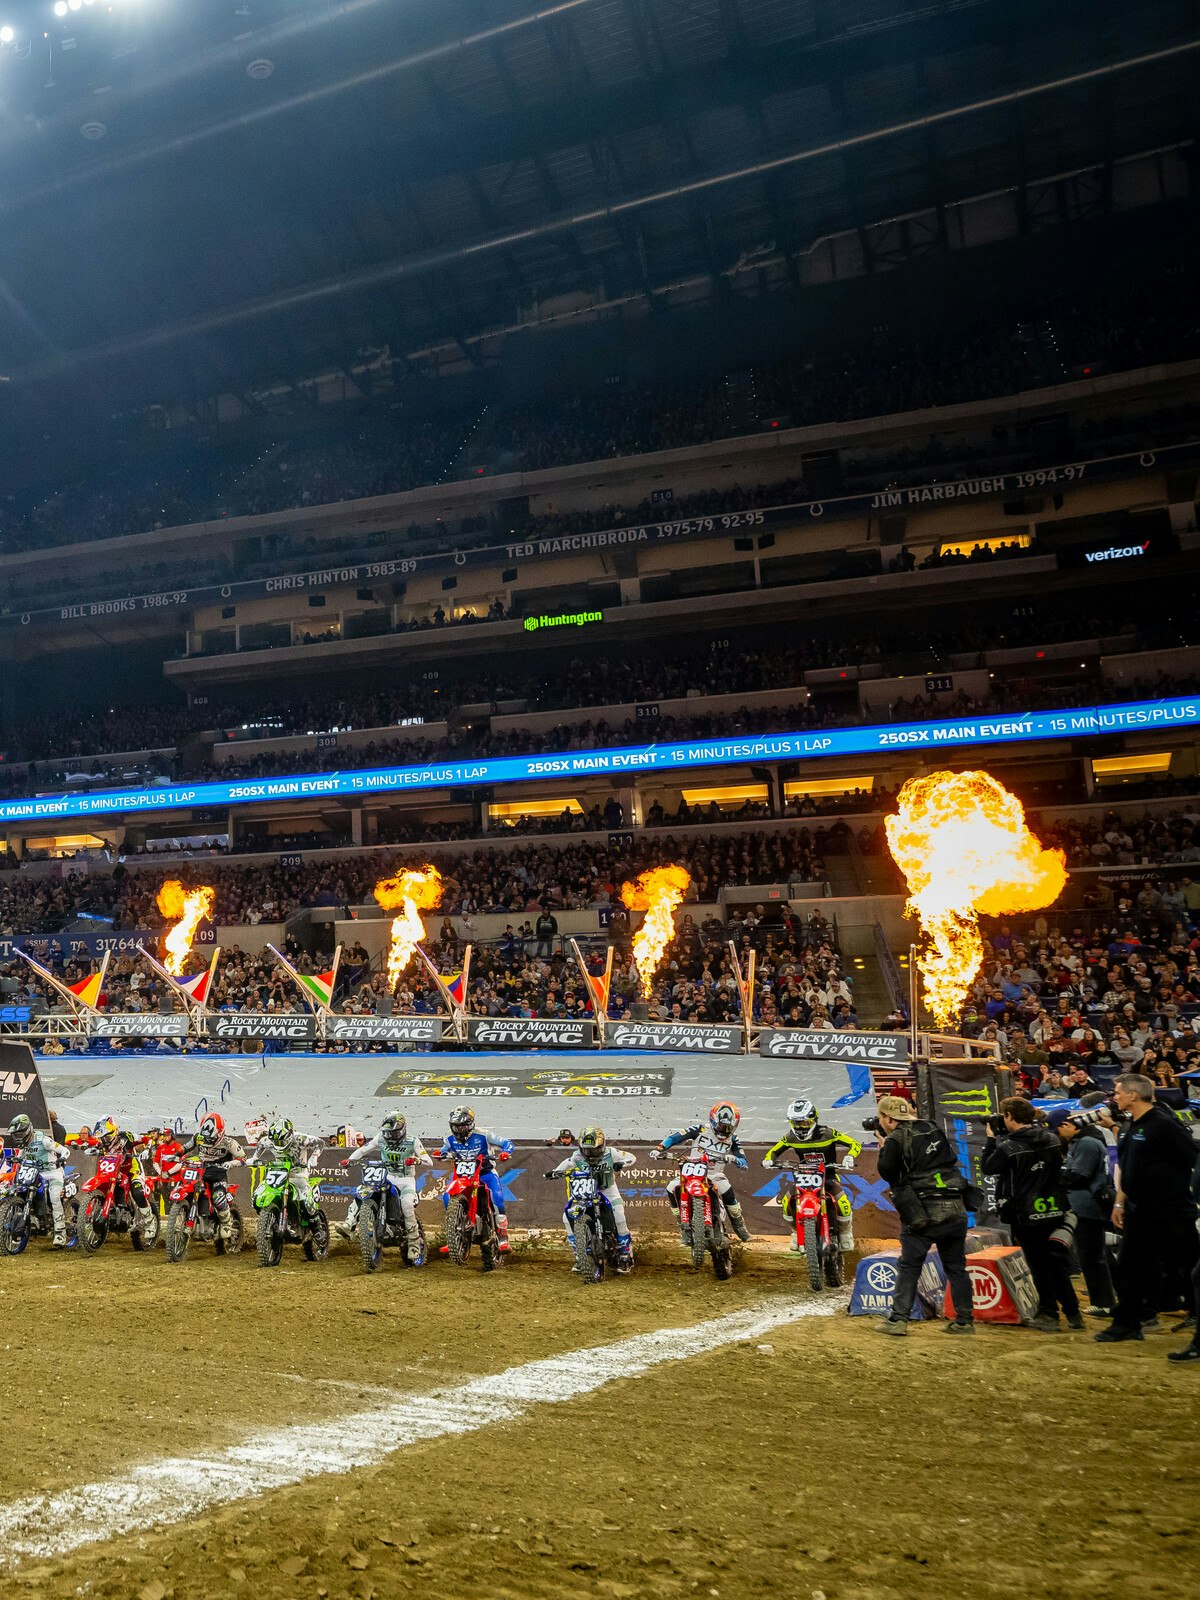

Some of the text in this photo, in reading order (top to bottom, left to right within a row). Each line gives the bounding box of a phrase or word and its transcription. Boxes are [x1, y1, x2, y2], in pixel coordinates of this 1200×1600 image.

[870, 465, 1087, 510] JIM HARBAUGH 1994-97
[653, 491, 671, 501] 510
[506, 511, 765, 559] TED MARCHIBRODA 92-95
[1084, 544, 1145, 562] verizon
[265, 560, 417, 592] CHRIS HINTON 1983-89
[61, 593, 187, 620] BILL BROOKS 1986-92
[539, 611, 603, 628] Huntington
[710, 639, 730, 651] 410
[422, 671, 439, 680] 409
[928, 678, 952, 690] 311
[637, 706, 658, 717] 310
[879, 706, 1197, 745] 250SX MAIN EVENT 15 MINUTES/PLUS
[319, 738, 337, 747] 309
[527, 738, 832, 774] 250SX MAIN EVENT 15 MINUTES/PLUS LAP
[229, 768, 487, 797] 250SX MAIN EVENT 15 MINUTES/PLUS LAP
[7, 805, 33, 816] MAIN
[35, 802, 69, 814] EVENT
[79, 801, 90, 810] 15
[91, 794, 166, 811] MINUTES/PLUS
[176, 792, 195, 803] LAP
[282, 856, 301, 867] 209
[110, 1016, 183, 1024] ROCKY MOUNTAIN
[230, 1017, 308, 1025] ROCKY MOUNTAIN
[350, 1018, 434, 1028] ROCKY MOUNTAIN
[492, 1021, 583, 1032] ROCKY MOUNTAIN
[633, 1024, 731, 1038] ROCKY MOUNTAIN
[789, 1032, 898, 1046] ROCKY MOUNTAIN
[401, 1085, 511, 1097] HARDER
[544, 1085, 663, 1097] HARDER
[965, 1121, 973, 1136] AMA
[384, 1145, 407, 1153] THOR
[699, 1136, 730, 1152] FXR
[100, 1161, 116, 1172] 96
[456, 1162, 477, 1175] 63
[681, 1162, 706, 1176] 66
[184, 1170, 198, 1180] 91
[266, 1171, 288, 1185] 57
[364, 1167, 385, 1181] 29
[795, 1174, 823, 1187] 330
[934, 1173, 946, 1188] 1
[65, 1183, 77, 1197] 58
[1034, 1197, 1059, 1213] 61
